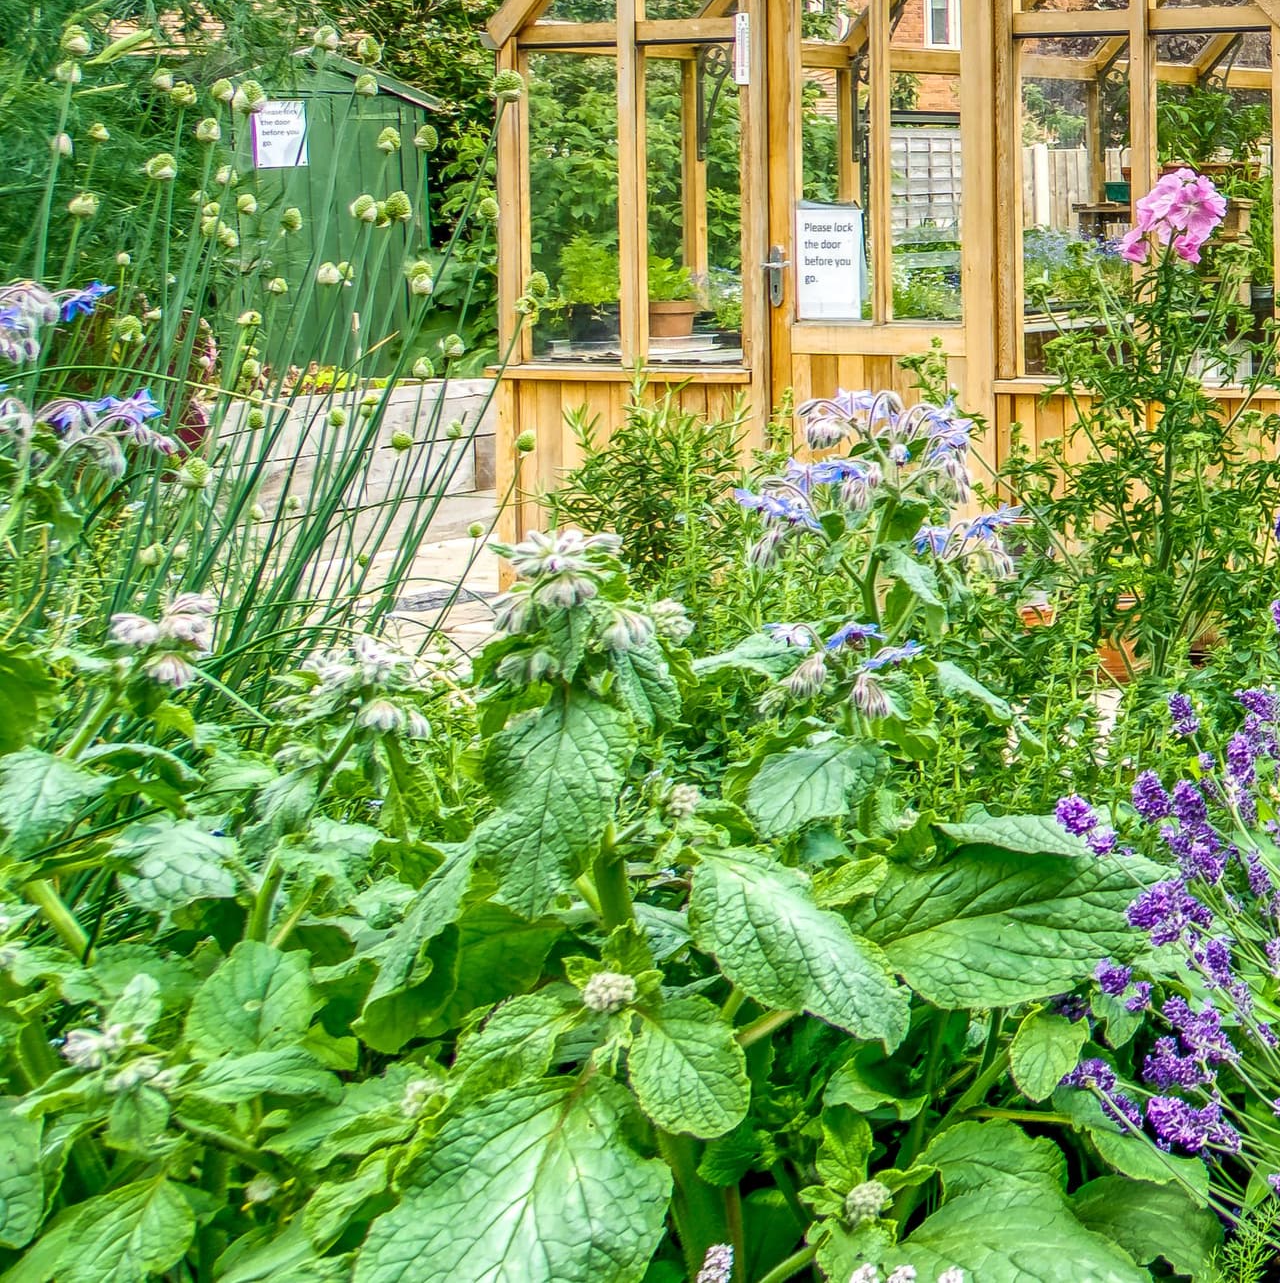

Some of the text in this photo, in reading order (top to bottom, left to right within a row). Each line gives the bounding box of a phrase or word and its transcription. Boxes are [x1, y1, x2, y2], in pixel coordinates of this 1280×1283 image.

[804, 222, 853, 232] Please lock
[804, 240, 842, 249] the door
[804, 256, 851, 268] before you
[804, 275, 819, 285] go.
